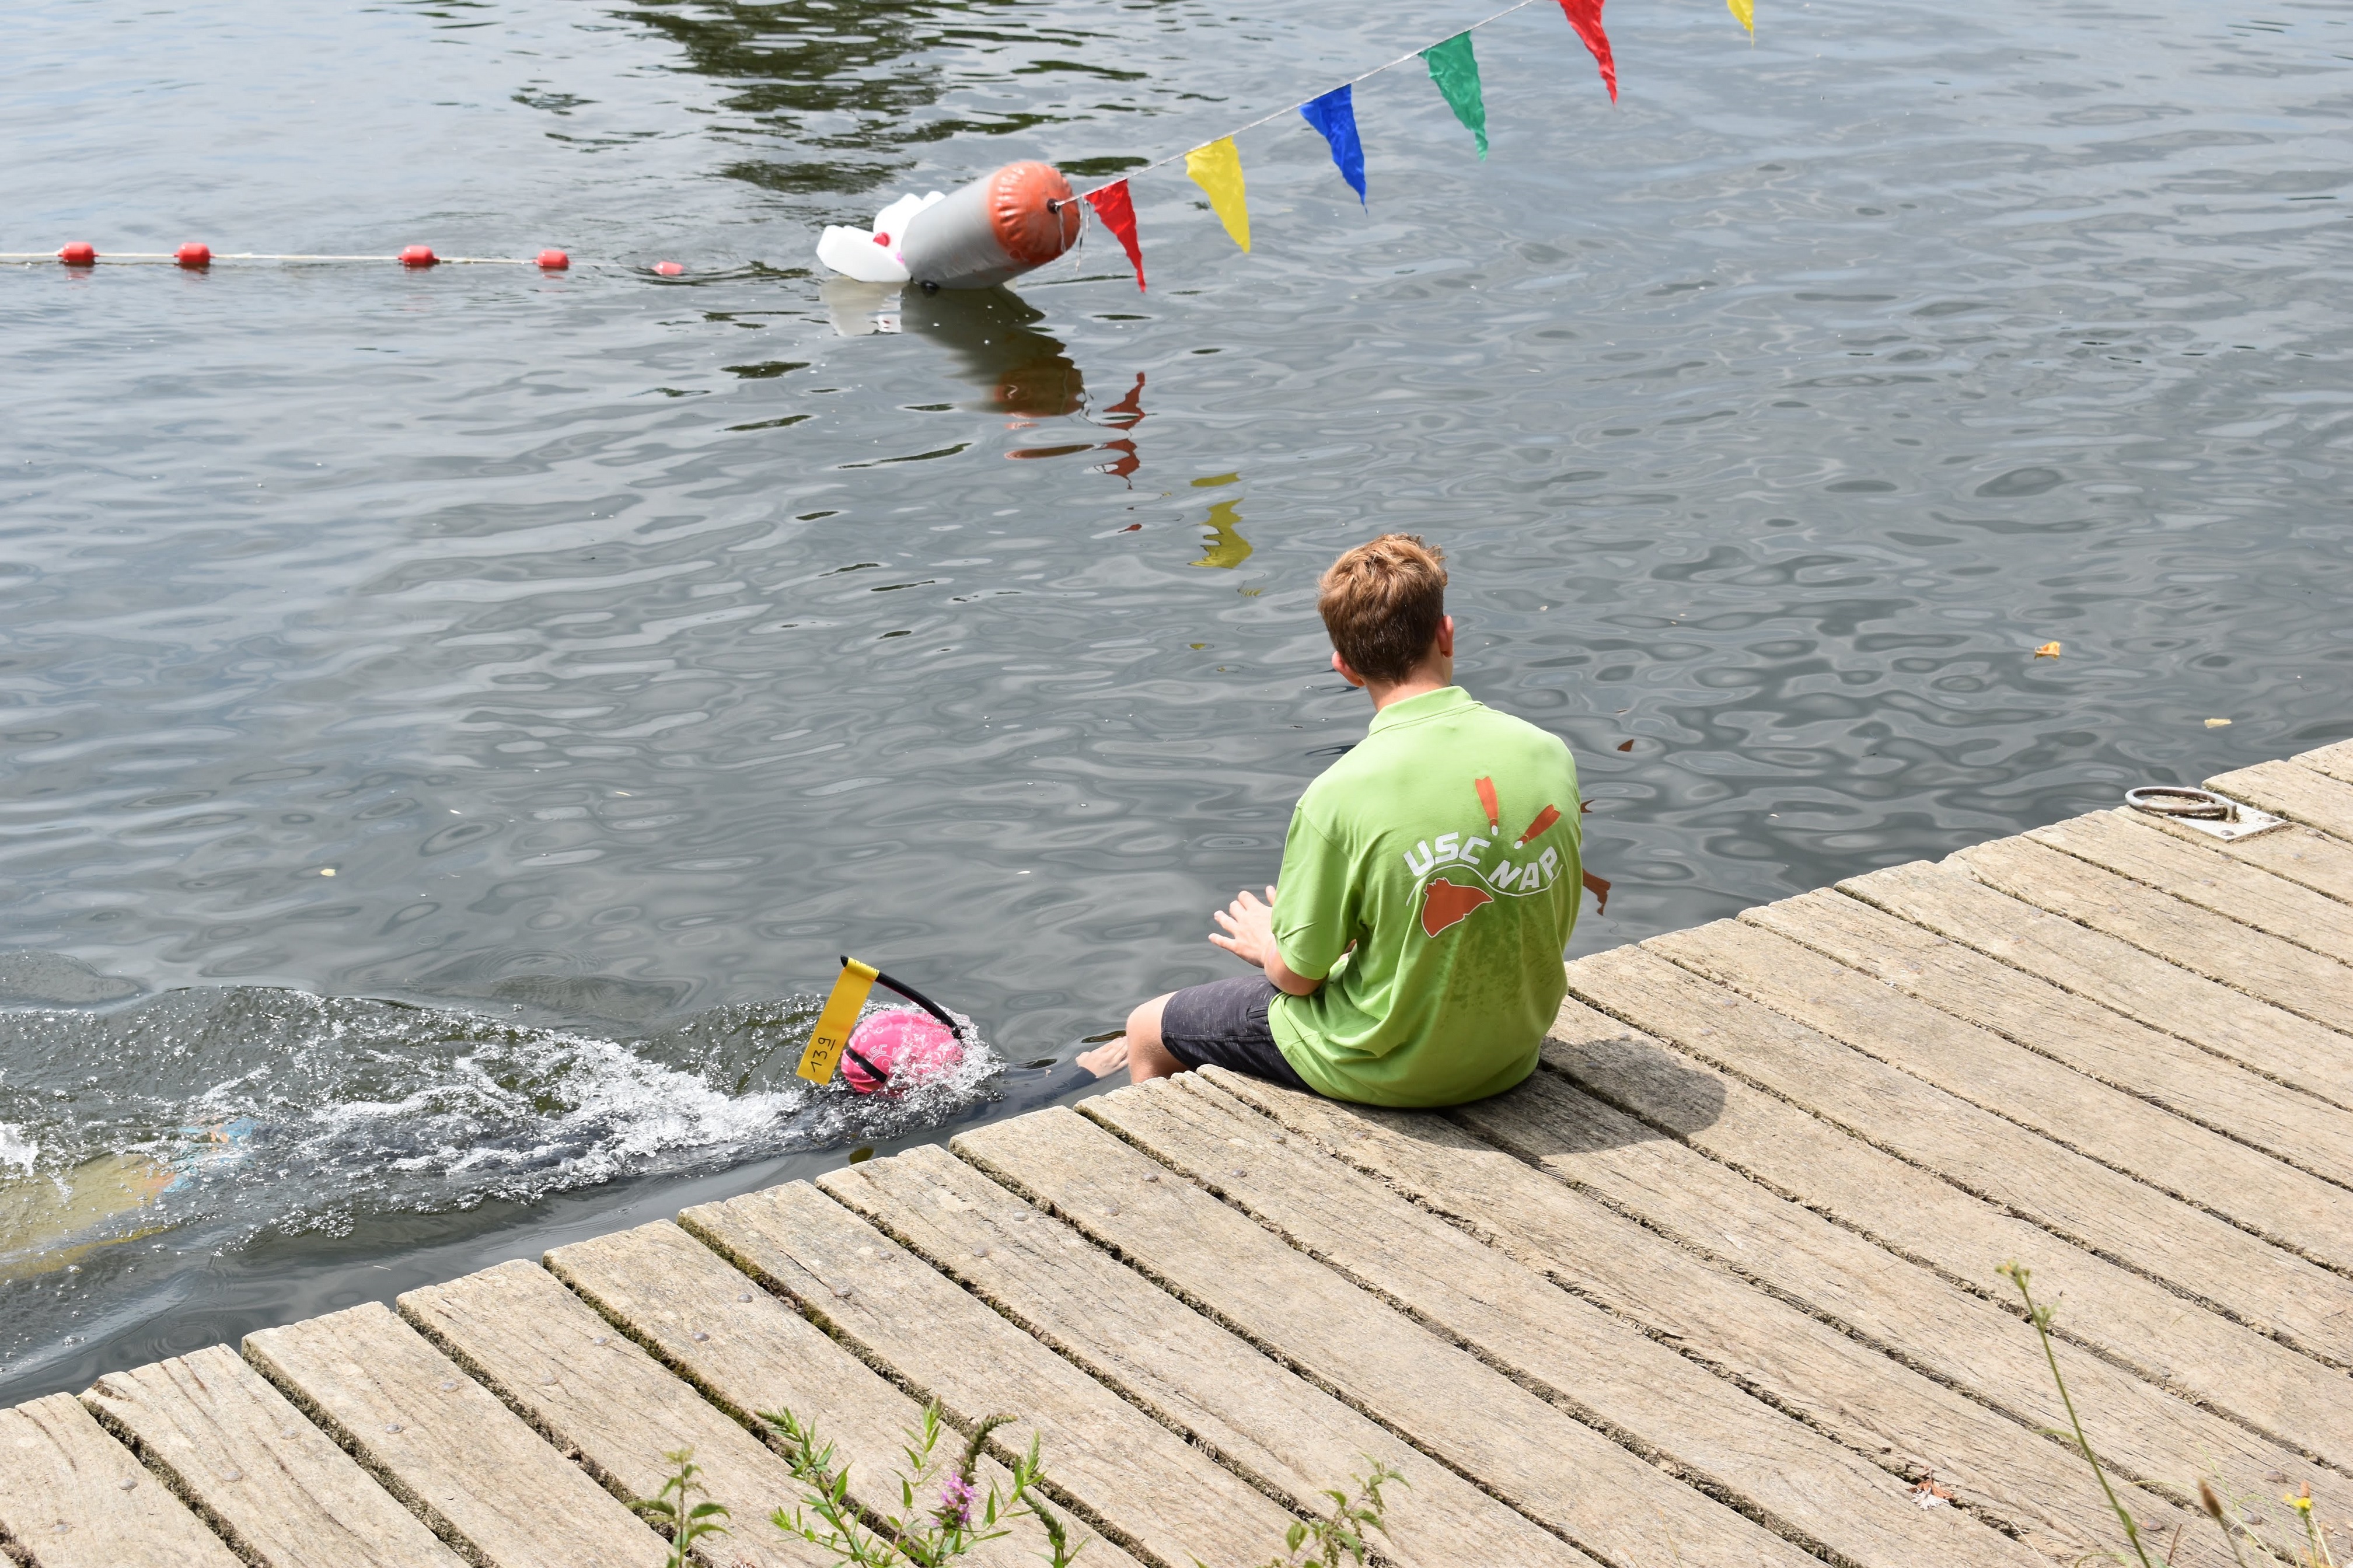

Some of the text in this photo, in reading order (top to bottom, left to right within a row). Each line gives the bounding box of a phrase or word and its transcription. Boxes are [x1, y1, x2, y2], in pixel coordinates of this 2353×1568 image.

[1404, 832, 1558, 890] USC NAP
[811, 1038, 833, 1073] 139
[864, 1045, 887, 1062] USC
